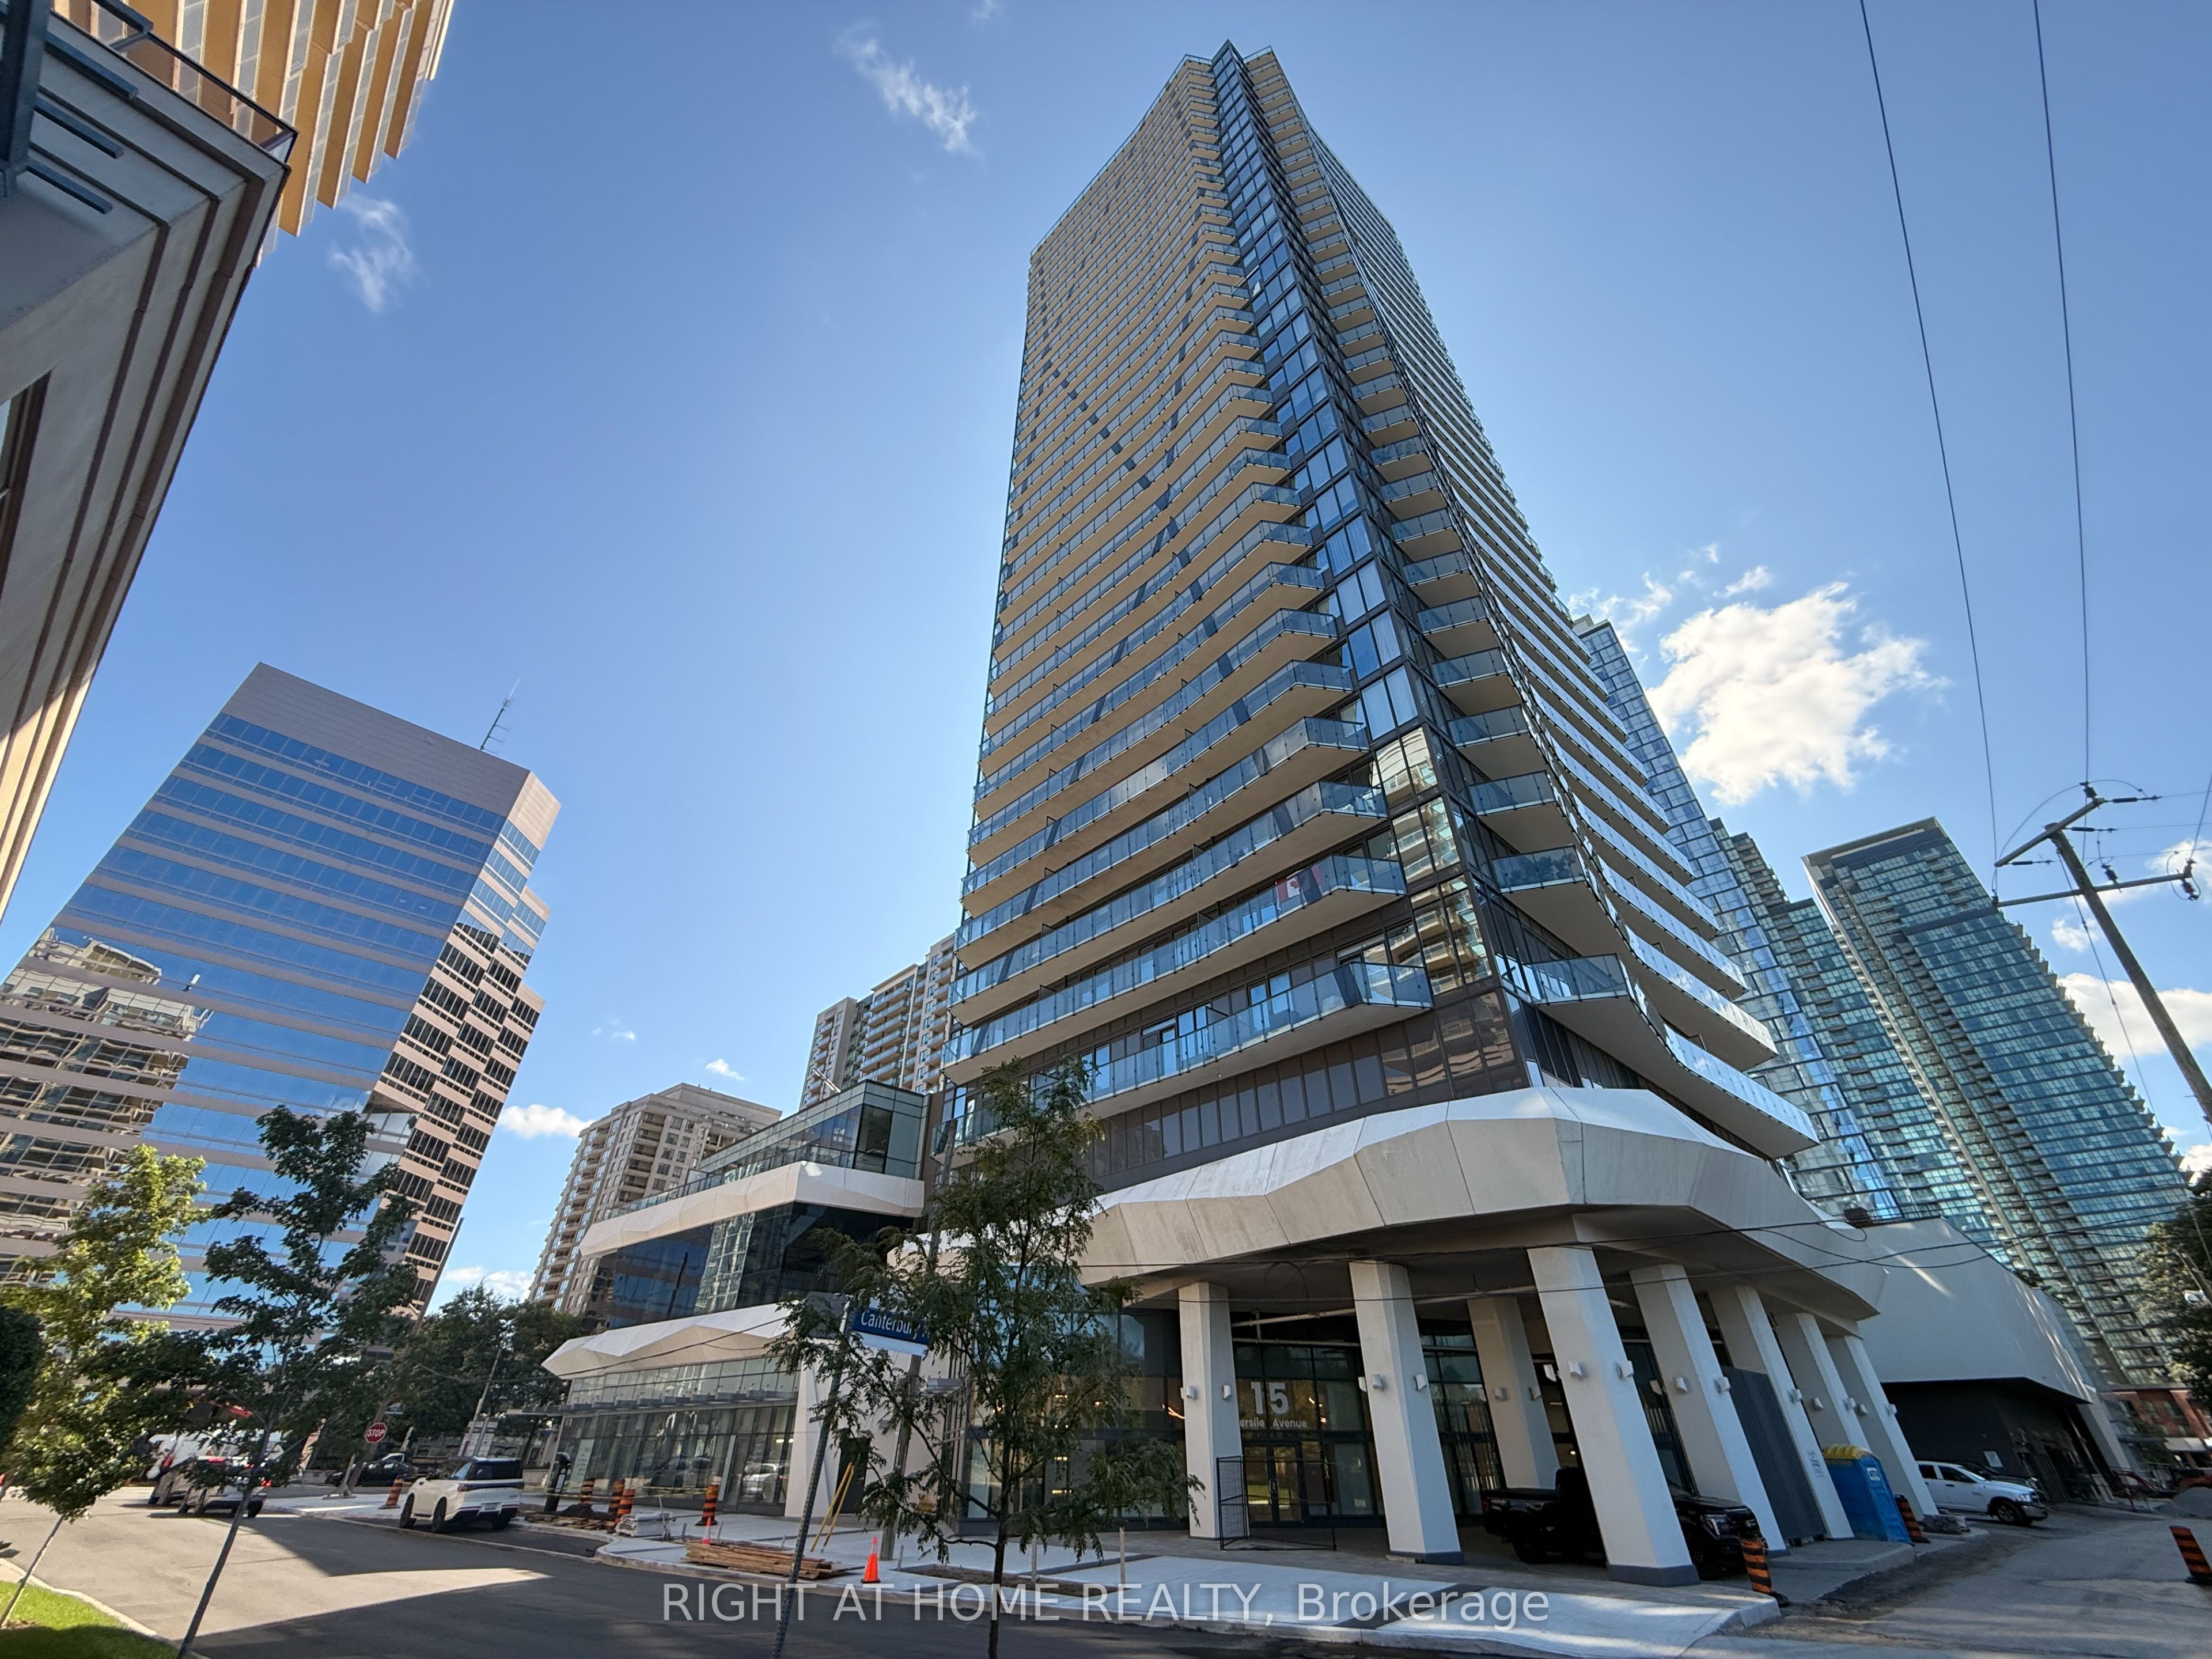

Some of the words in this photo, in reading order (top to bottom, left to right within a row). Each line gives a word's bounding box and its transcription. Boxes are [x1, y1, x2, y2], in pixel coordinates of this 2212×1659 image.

[1250, 1381, 1289, 1415] 15
[1272, 1418, 1308, 1428] Avenue
[366, 1429, 385, 1437] STOP
